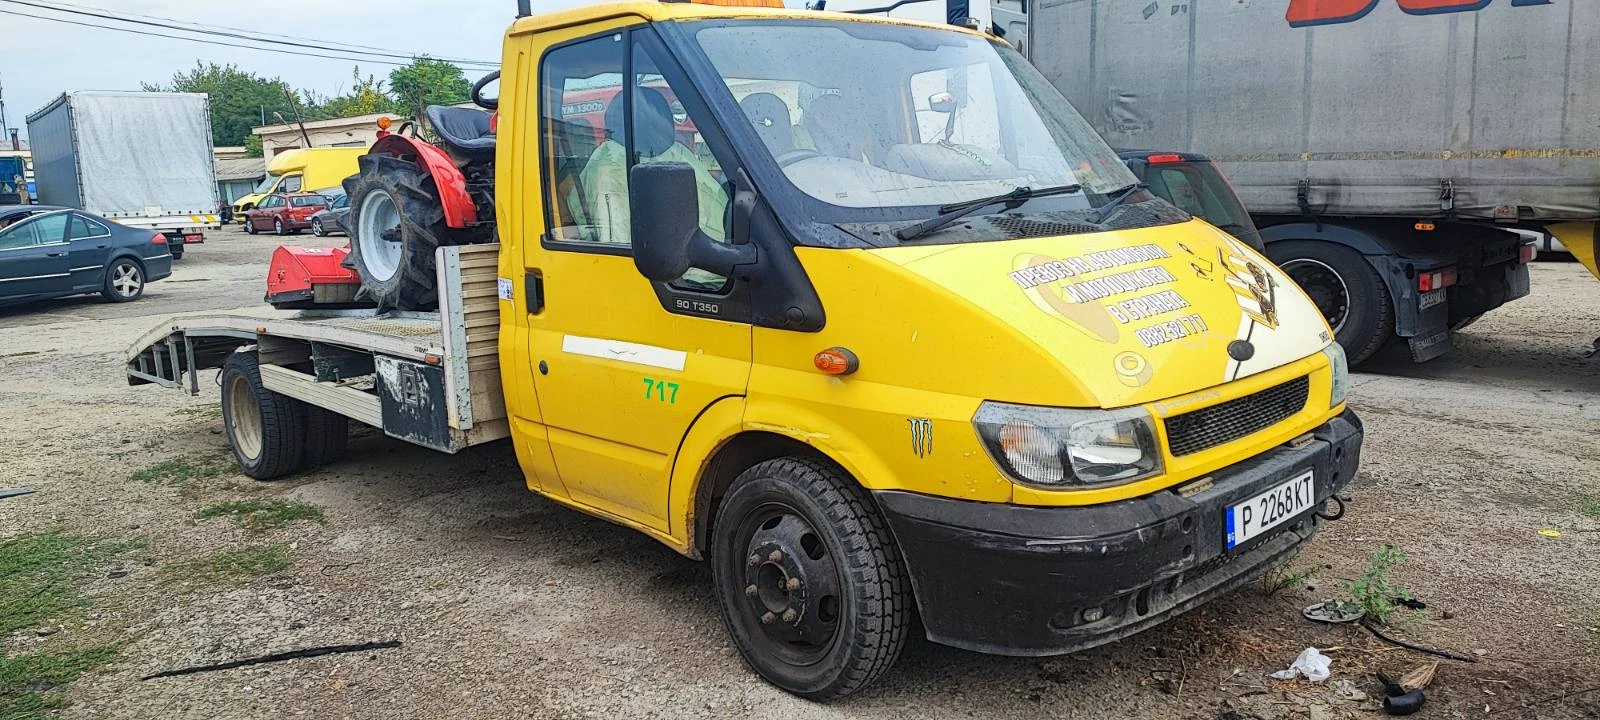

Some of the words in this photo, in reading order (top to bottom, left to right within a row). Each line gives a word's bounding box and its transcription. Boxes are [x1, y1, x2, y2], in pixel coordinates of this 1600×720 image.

[1008, 261, 1075, 289] ПРЕВОЗ
[1062, 256, 1094, 274] НА
[676, 299, 690, 309] 90
[692, 301, 719, 313] T350
[1062, 286, 1089, 304] И
[1105, 304, 1129, 324] В
[1118, 289, 1191, 320] СТРАНАТА
[1135, 326, 1172, 348] 0882
[643, 377, 679, 404] 717
[1242, 505, 1252, 537] P
[1260, 486, 1293, 527] 2268
[1295, 475, 1311, 510] KT
